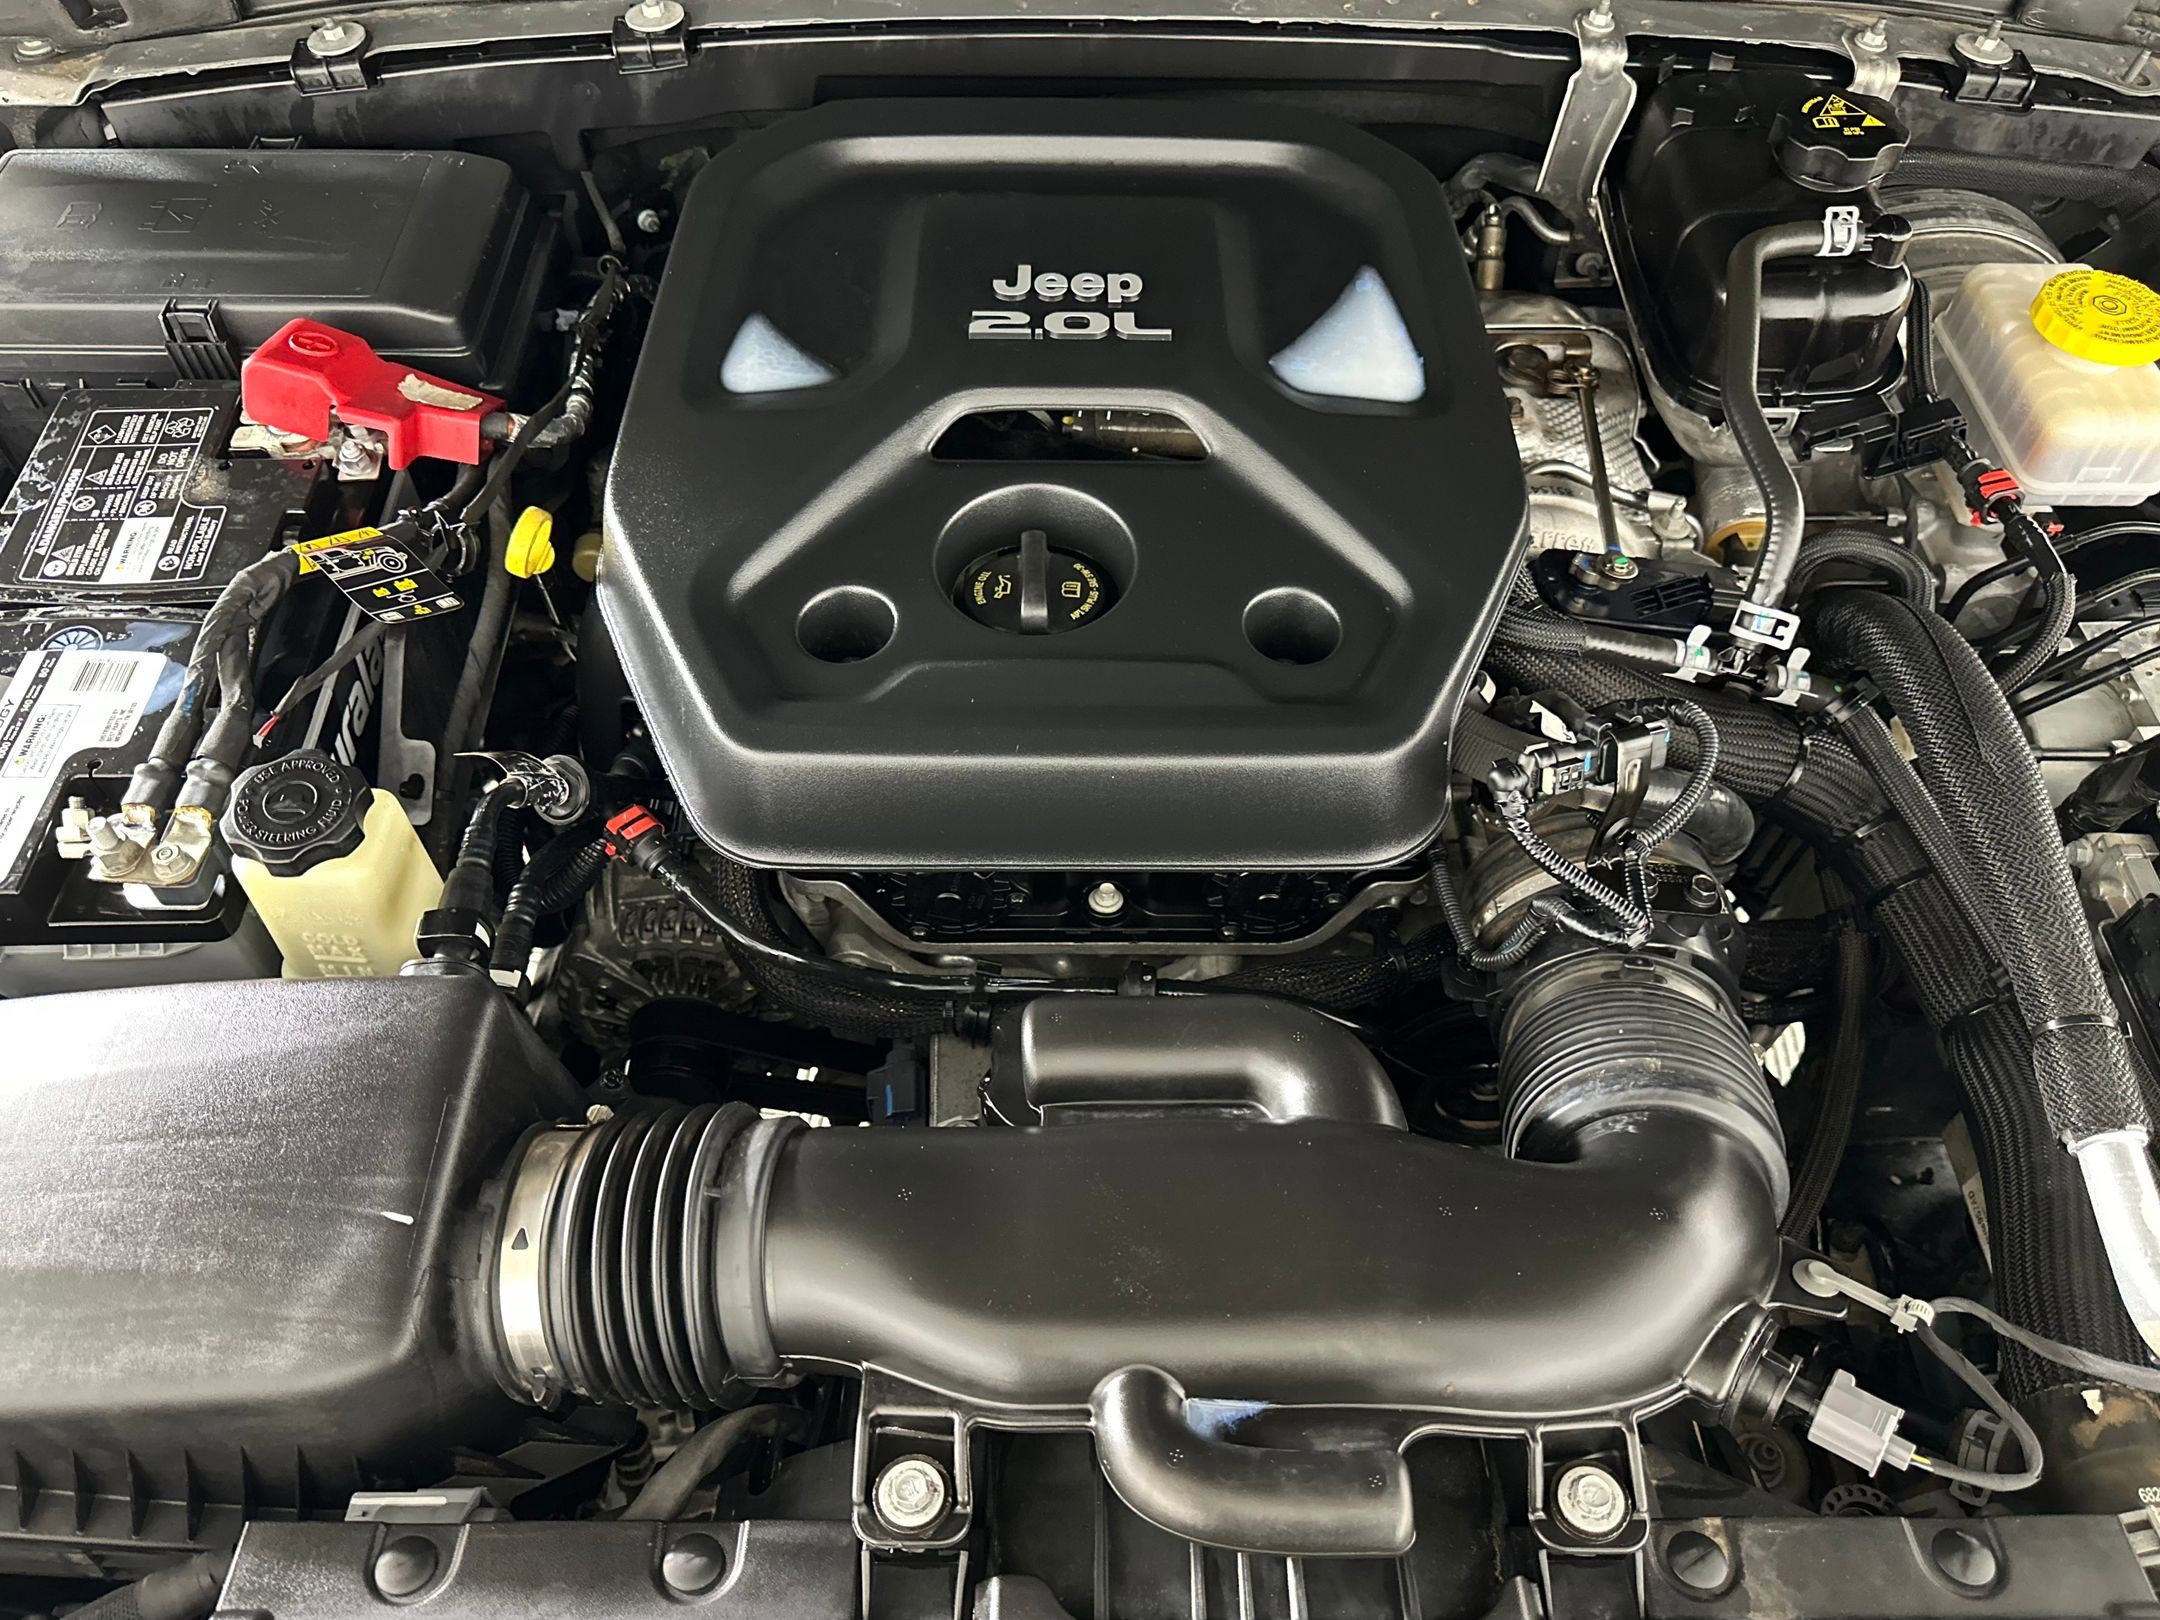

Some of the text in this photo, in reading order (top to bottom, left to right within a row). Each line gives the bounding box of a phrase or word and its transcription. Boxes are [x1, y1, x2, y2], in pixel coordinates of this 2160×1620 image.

[992, 264, 1143, 308] Jeep
[968, 310, 1172, 341] 2.0L
[156, 453, 168, 463] DO
[166, 450, 178, 464] NOT
[37, 468, 82, 546] DANGER/POISON
[165, 539, 177, 554] READ
[183, 516, 210, 569] NON-SPILLABLE
[973, 570, 992, 605] ENGINE OIL
[1089, 590, 1099, 606] PLUS
[18, 714, 47, 755] WARNING:
[254, 758, 341, 785] USE APPROVED
[254, 825, 318, 845] STEERING
[317, 799, 343, 829] FLUID
[301, 931, 359, 946] COLD
[306, 943, 365, 958] MAX
[2138, 1486, 2160, 1503] 682
